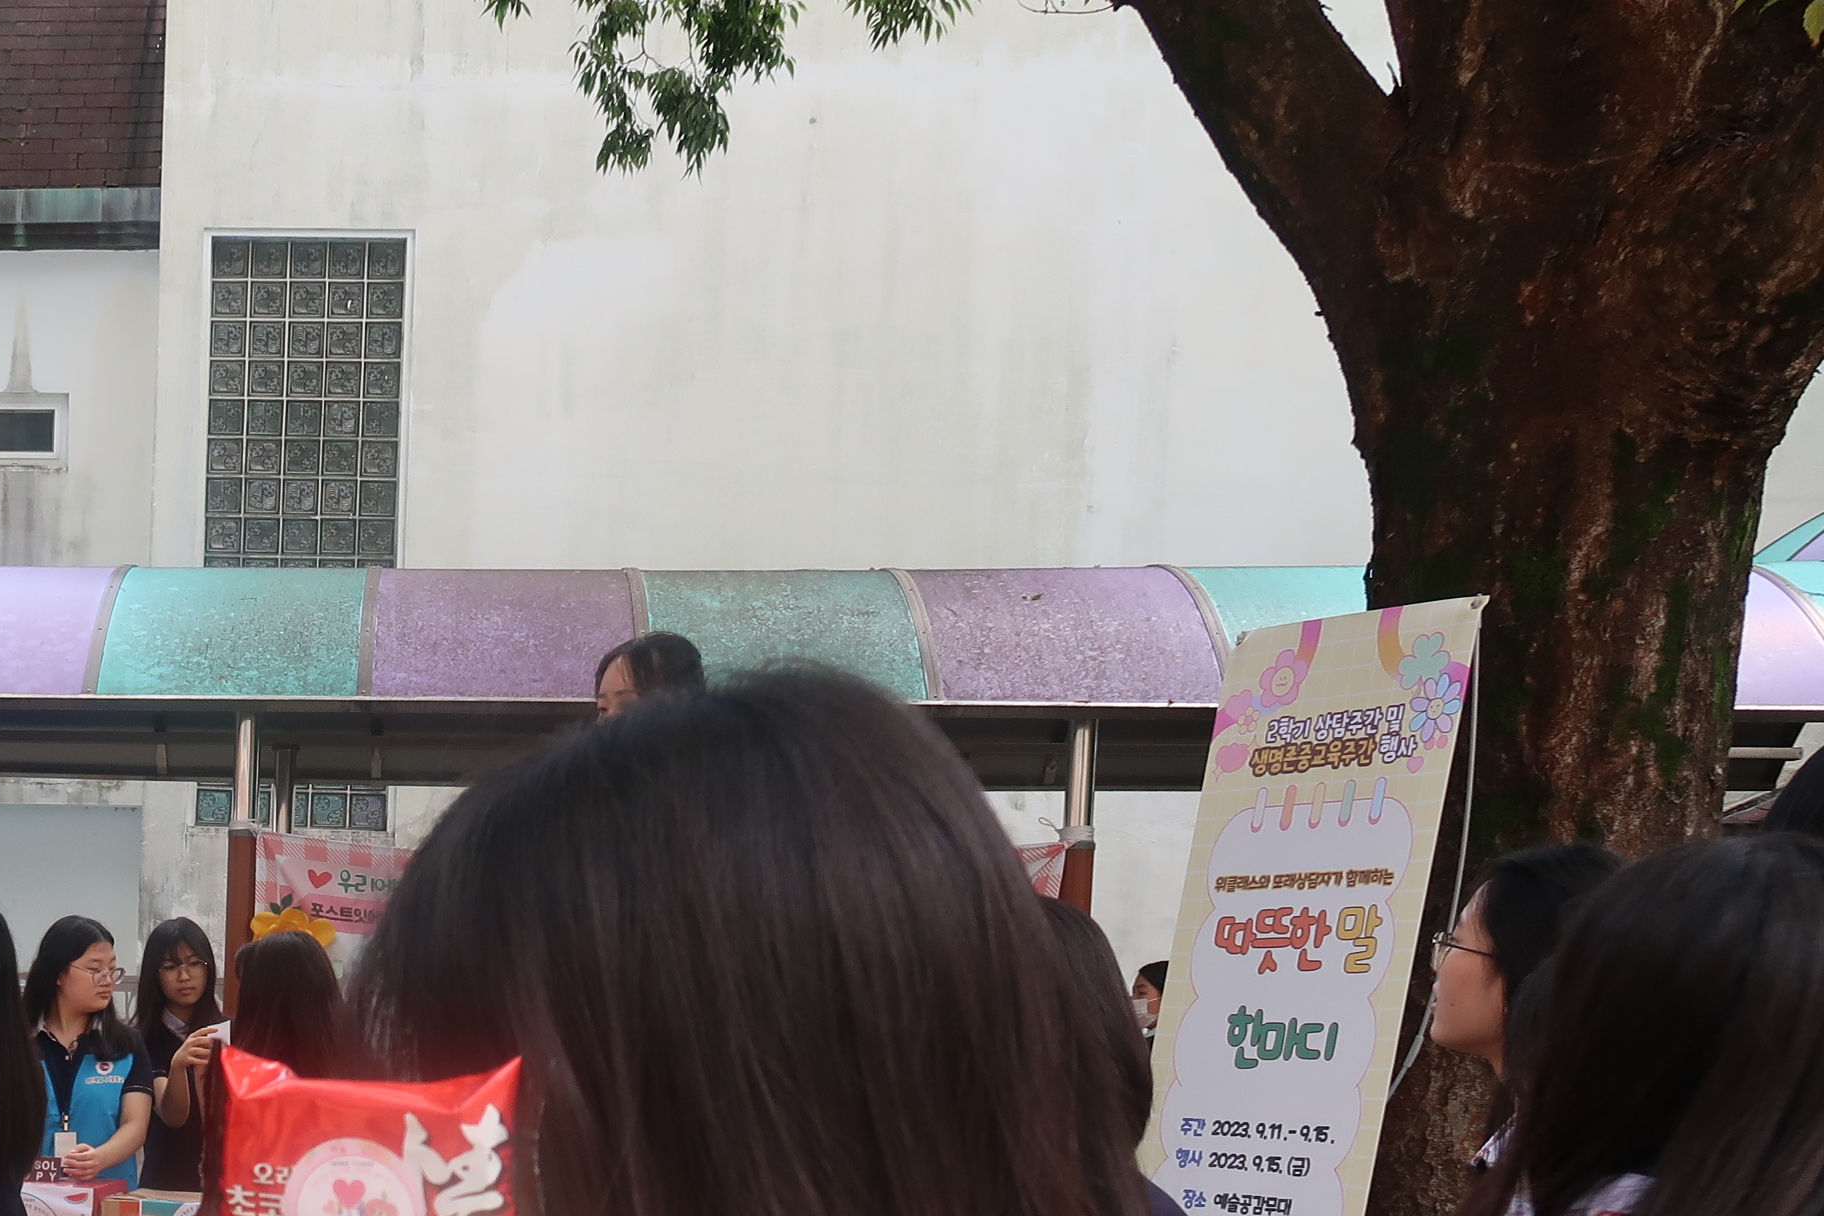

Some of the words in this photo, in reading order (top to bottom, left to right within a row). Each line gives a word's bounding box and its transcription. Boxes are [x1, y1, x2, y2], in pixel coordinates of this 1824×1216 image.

[1266, 716, 1312, 744] 2학기
[1314, 707, 1384, 742] 상담주간
[1386, 704, 1405, 734] 및
[1249, 736, 1376, 777] 생명존중교육주간
[1378, 733, 1418, 764] 행사
[1214, 874, 1271, 893] 위클래스와
[1271, 869, 1344, 891] 또래상담자가
[1345, 867, 1395, 888] 함께하는
[1214, 906, 1332, 975] 따뜻한
[1335, 904, 1383, 974] 말
[1227, 1004, 1339, 1069] 한마디
[1180, 1117, 1207, 1138] 주간
[1175, 1147, 1204, 1168] 행사
[1286, 1156, 1311, 1177] (금)
[1182, 1189, 1208, 1209] 장소
[1213, 1192, 1293, 1216] 예술공감무대
